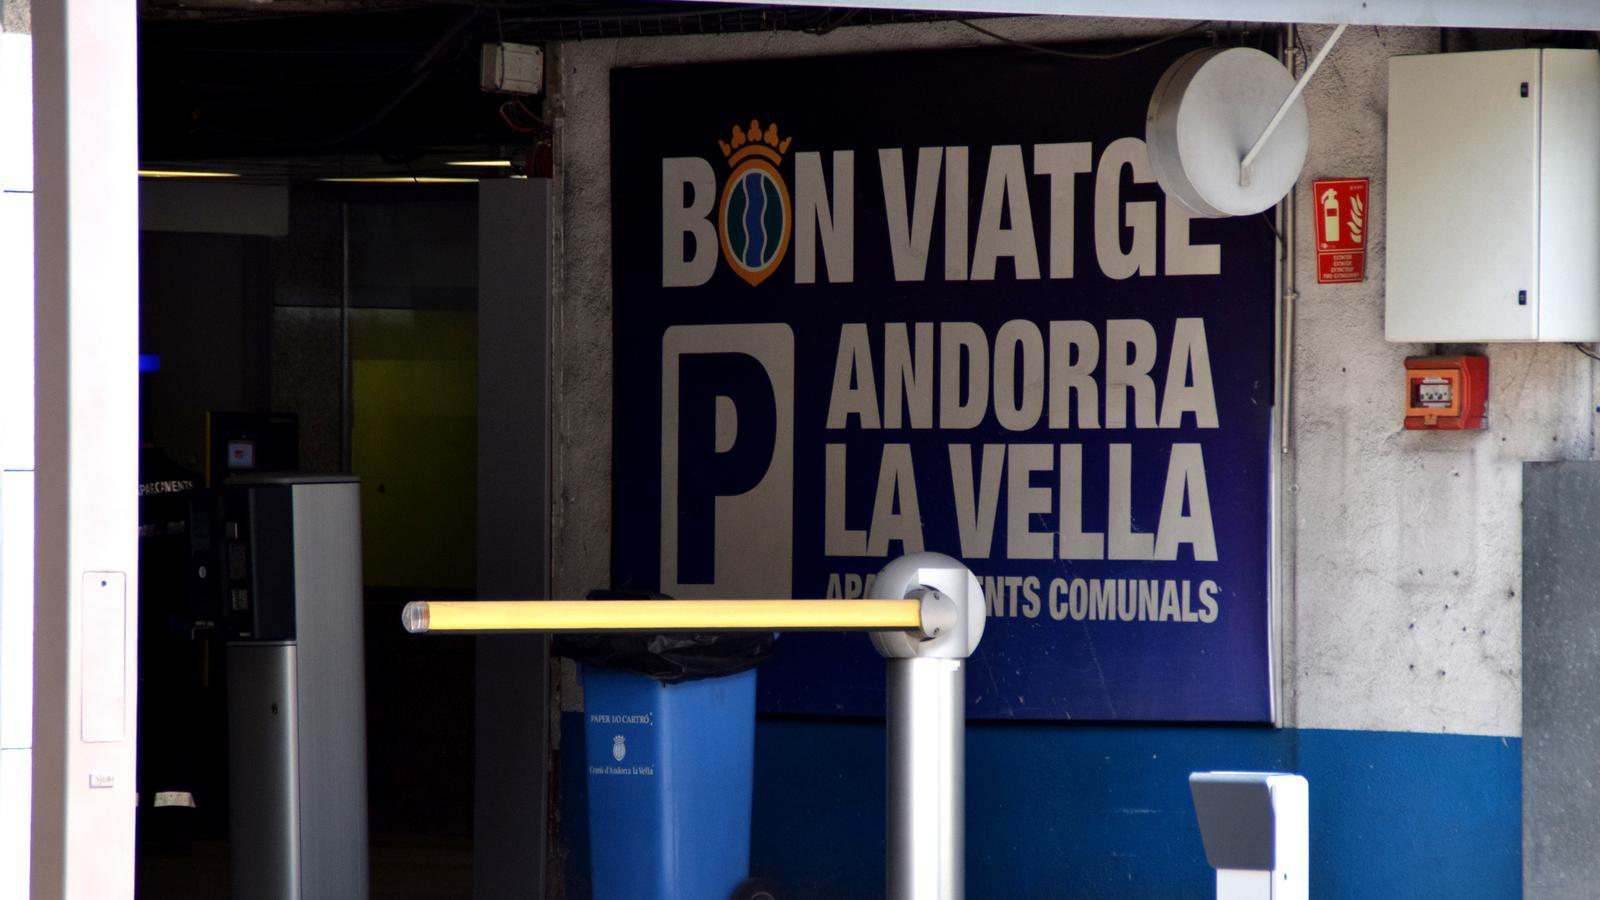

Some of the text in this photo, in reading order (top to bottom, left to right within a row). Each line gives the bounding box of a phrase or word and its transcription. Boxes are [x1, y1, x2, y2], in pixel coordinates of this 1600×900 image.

[661, 149, 854, 287] BON
[825, 317, 1220, 432] ANDORRA
[678, 351, 778, 585] P
[825, 443, 1219, 561] LA VELLA
[1049, 575, 1219, 624] COMUNALS
